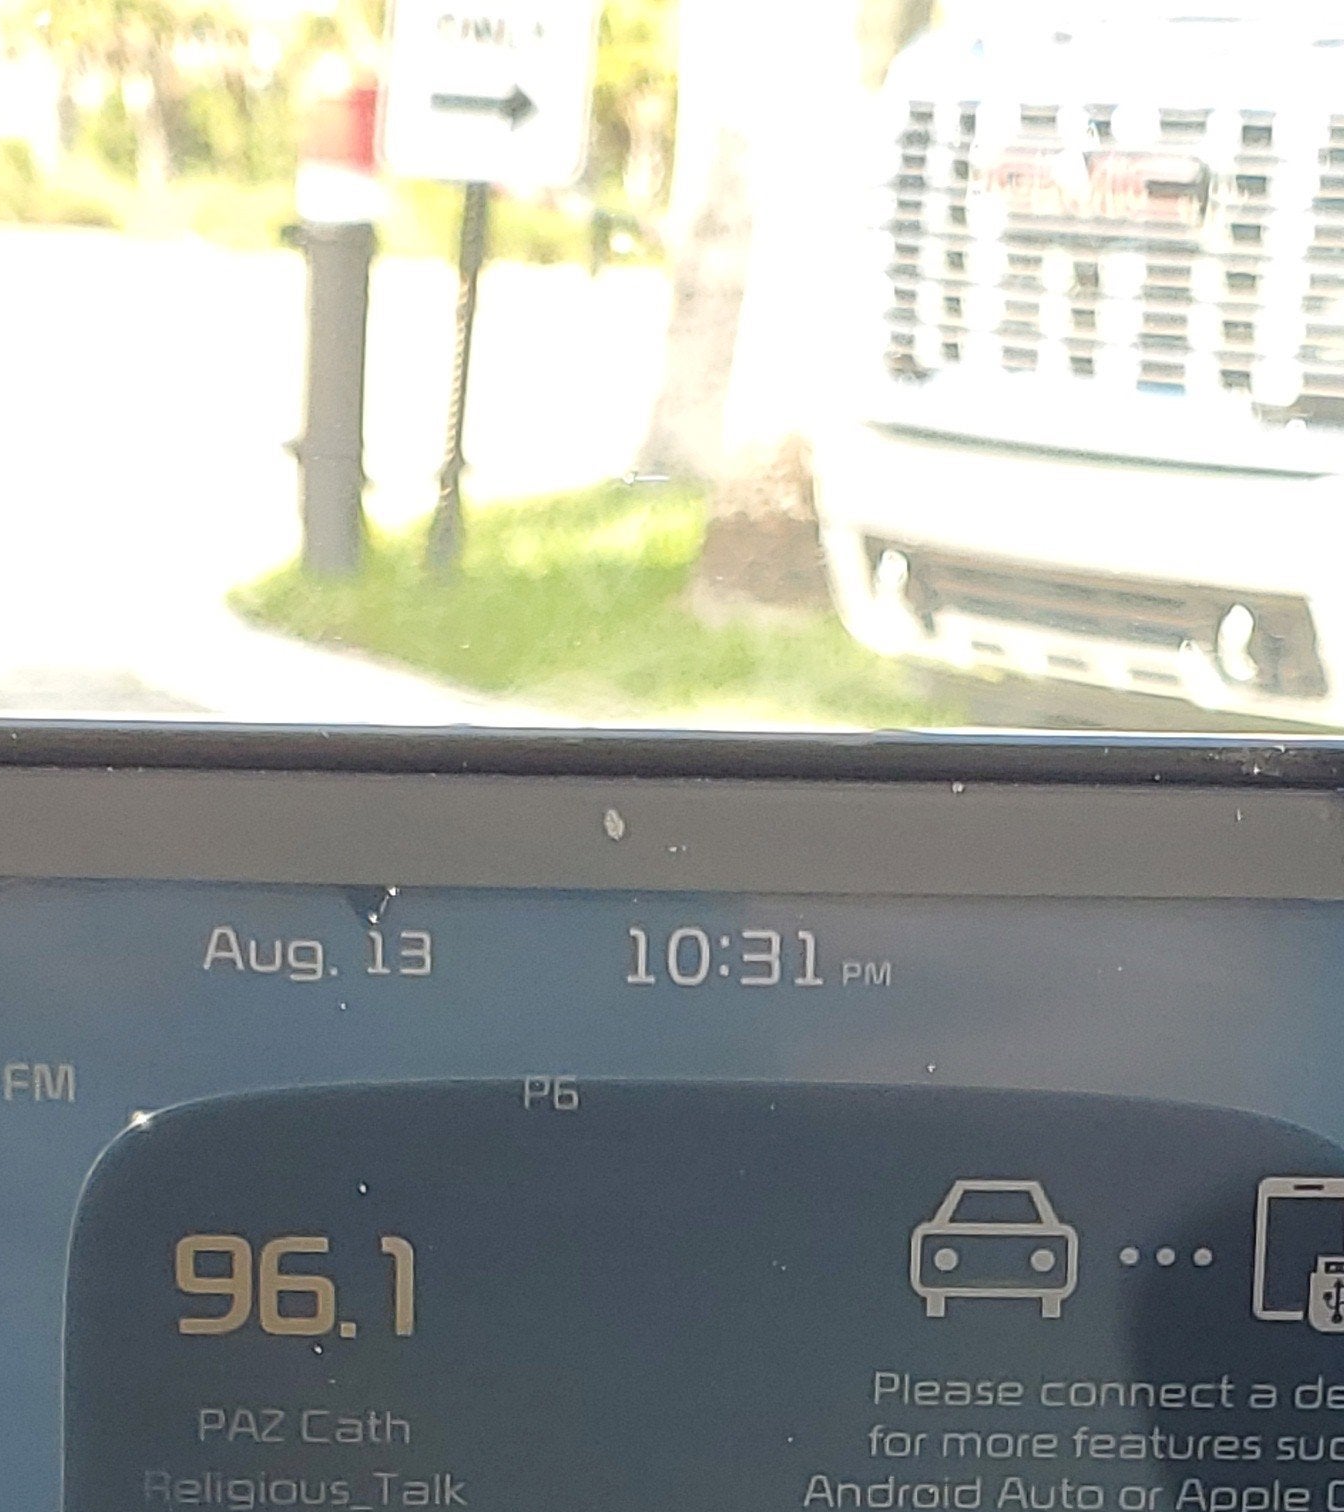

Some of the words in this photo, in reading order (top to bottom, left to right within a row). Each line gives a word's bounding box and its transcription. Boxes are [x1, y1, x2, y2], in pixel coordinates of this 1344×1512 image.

[202, 925, 338, 982] Aug.
[365, 931, 433, 977] 13
[625, 927, 825, 987] 10:31
[841, 962, 893, 987] PM
[2, 1062, 77, 1103] FM
[174, 1235, 416, 1338] 96.1
[872, 1370, 1024, 1408] Please
[1039, 1376, 1235, 1410] connect
[1250, 1383, 1276, 1409] a
[199, 1408, 286, 1443] PAZ
[300, 1409, 411, 1445] Cath
[867, 1425, 926, 1458] for
[942, 1431, 1058, 1459] more
[1072, 1427, 1262, 1461] features
[803, 1474, 981, 1510] Android
[996, 1476, 1104, 1511] Auto
[1117, 1484, 1163, 1511] or
